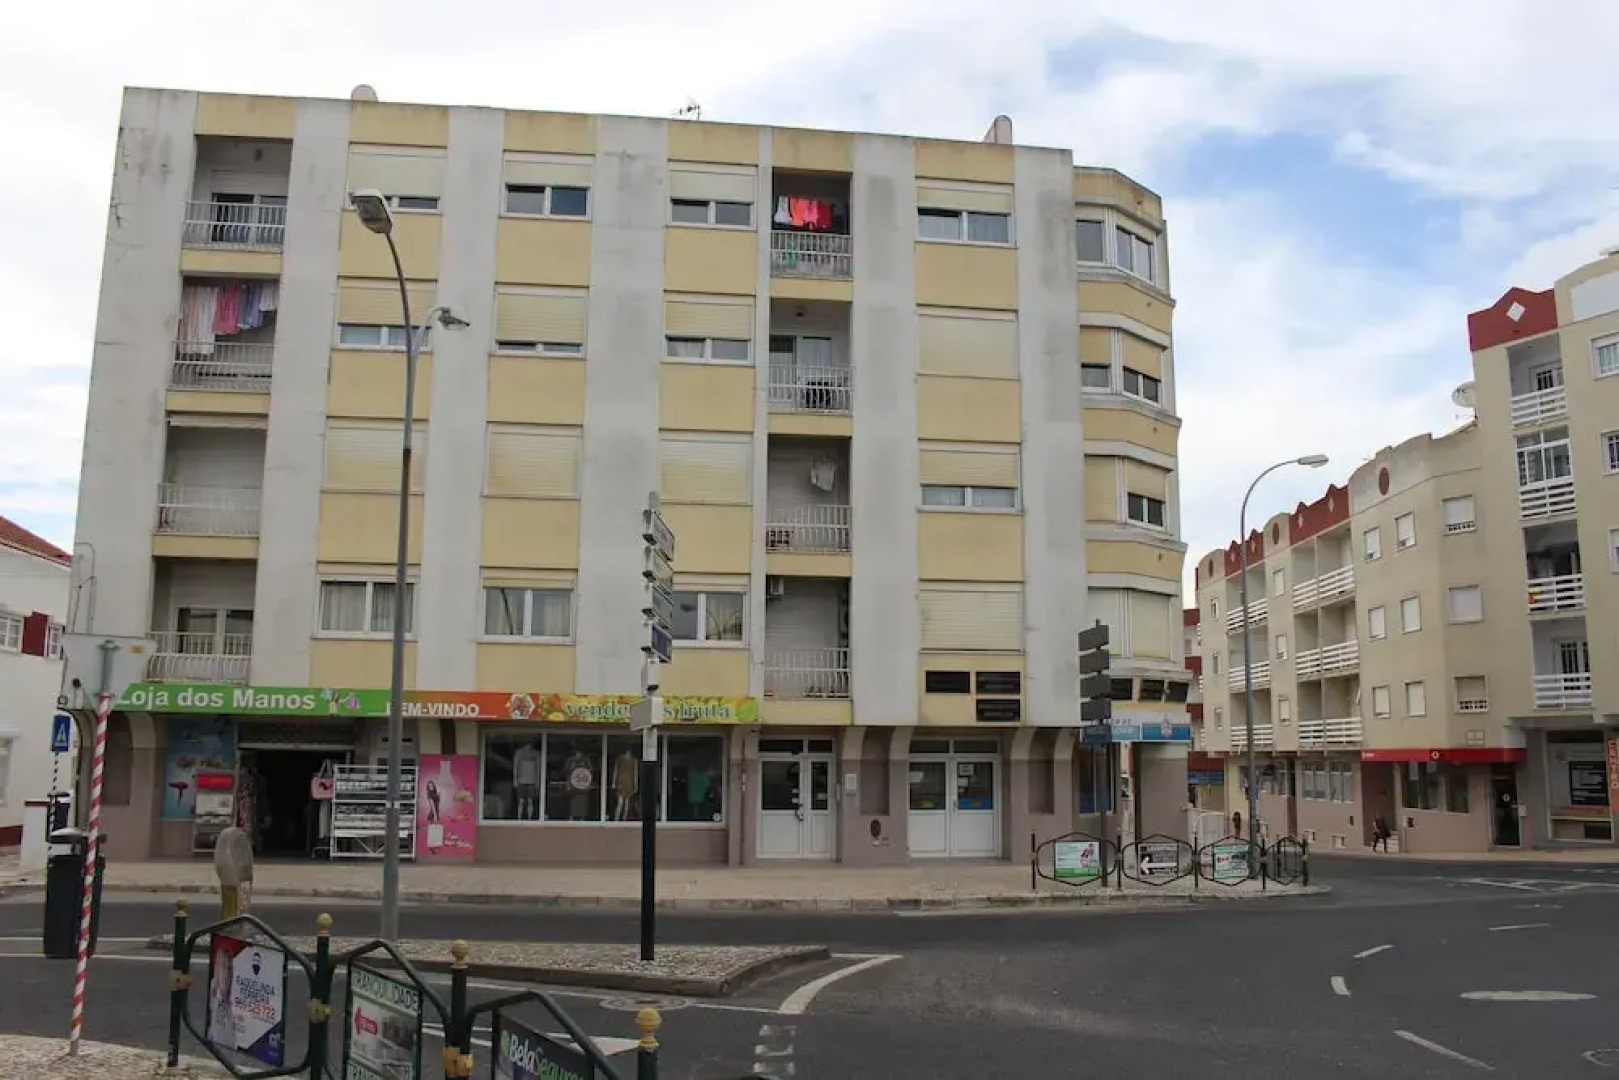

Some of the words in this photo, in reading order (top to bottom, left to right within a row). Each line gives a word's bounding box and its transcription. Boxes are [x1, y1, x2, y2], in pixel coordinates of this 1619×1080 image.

[177, 687, 224, 707] dos
[232, 689, 316, 709] Manos
[386, 702, 480, 717] EM-VINDO
